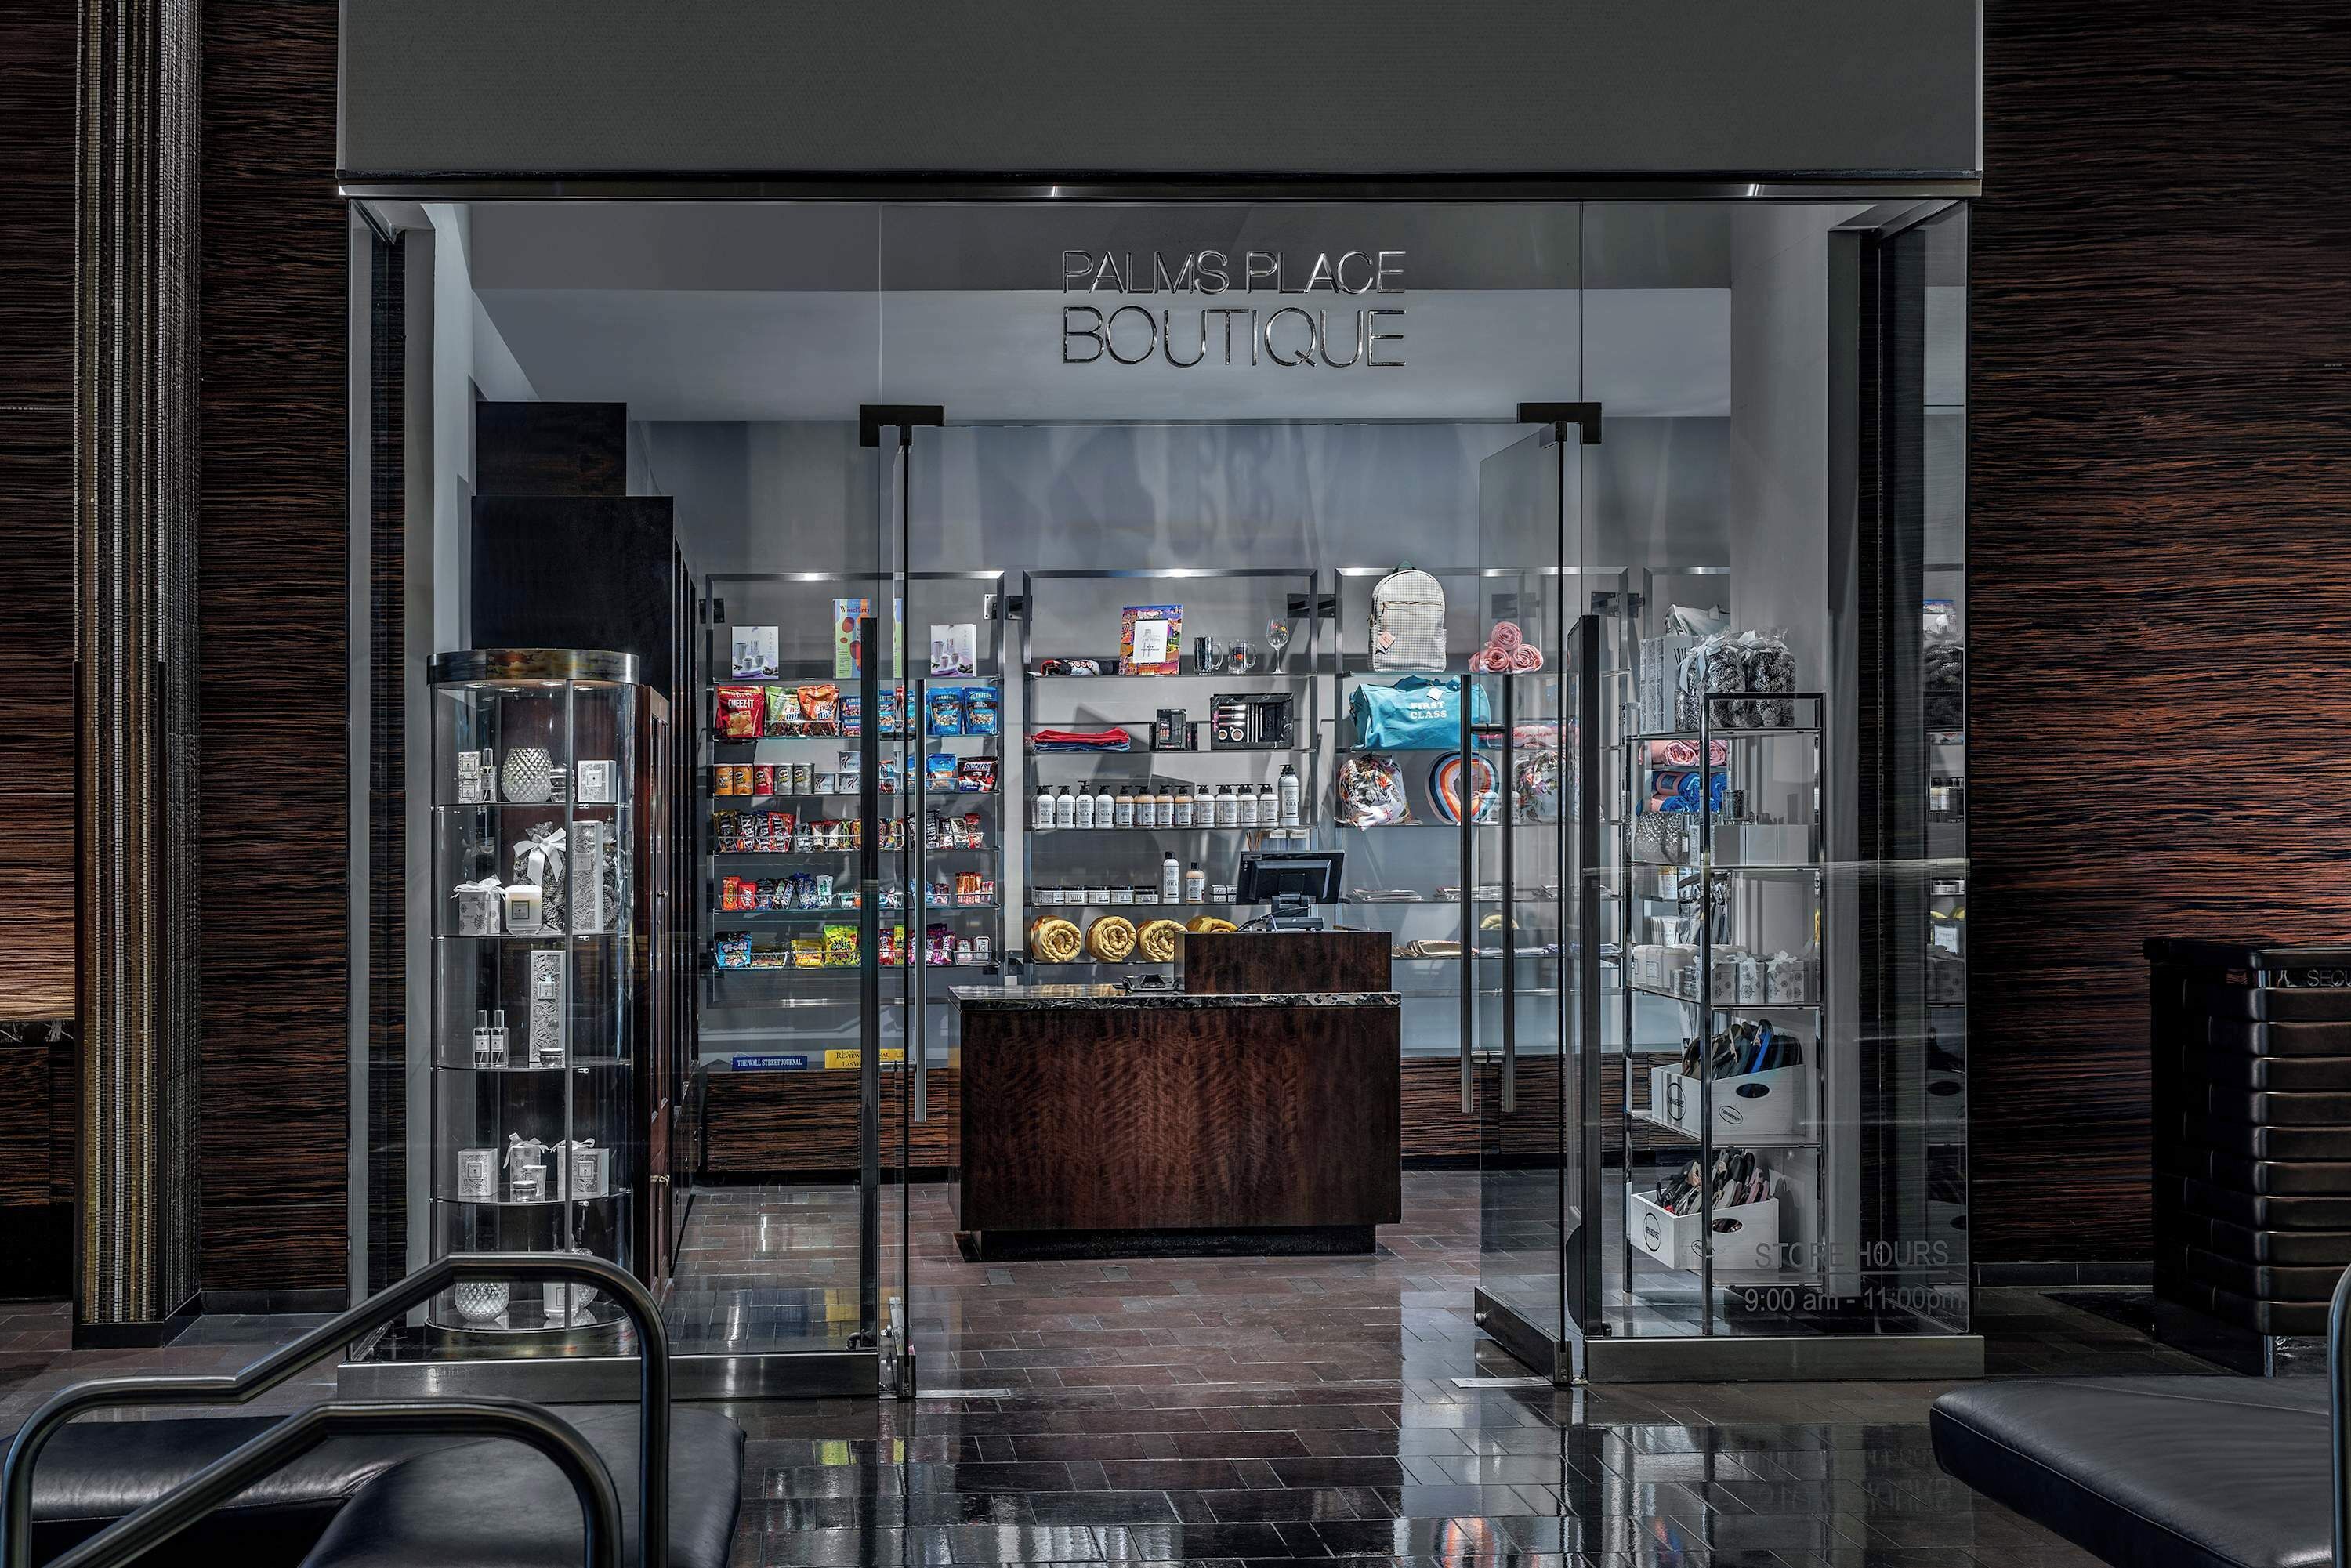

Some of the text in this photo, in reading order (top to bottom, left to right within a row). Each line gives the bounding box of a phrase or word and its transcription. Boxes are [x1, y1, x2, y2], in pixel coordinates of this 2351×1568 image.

[1063, 250, 1407, 294] PALMS PLACE
[1063, 306, 1407, 368] BOUTIQUE
[1410, 701, 1445, 710] FIRST
[1410, 709, 1447, 719] CLASS
[1755, 1240, 1949, 1268] STORE HOURS
[1744, 1287, 1795, 1313] 9:00
[1802, 1292, 1839, 1312] am
[1864, 1287, 1962, 1316] 11:00pm
